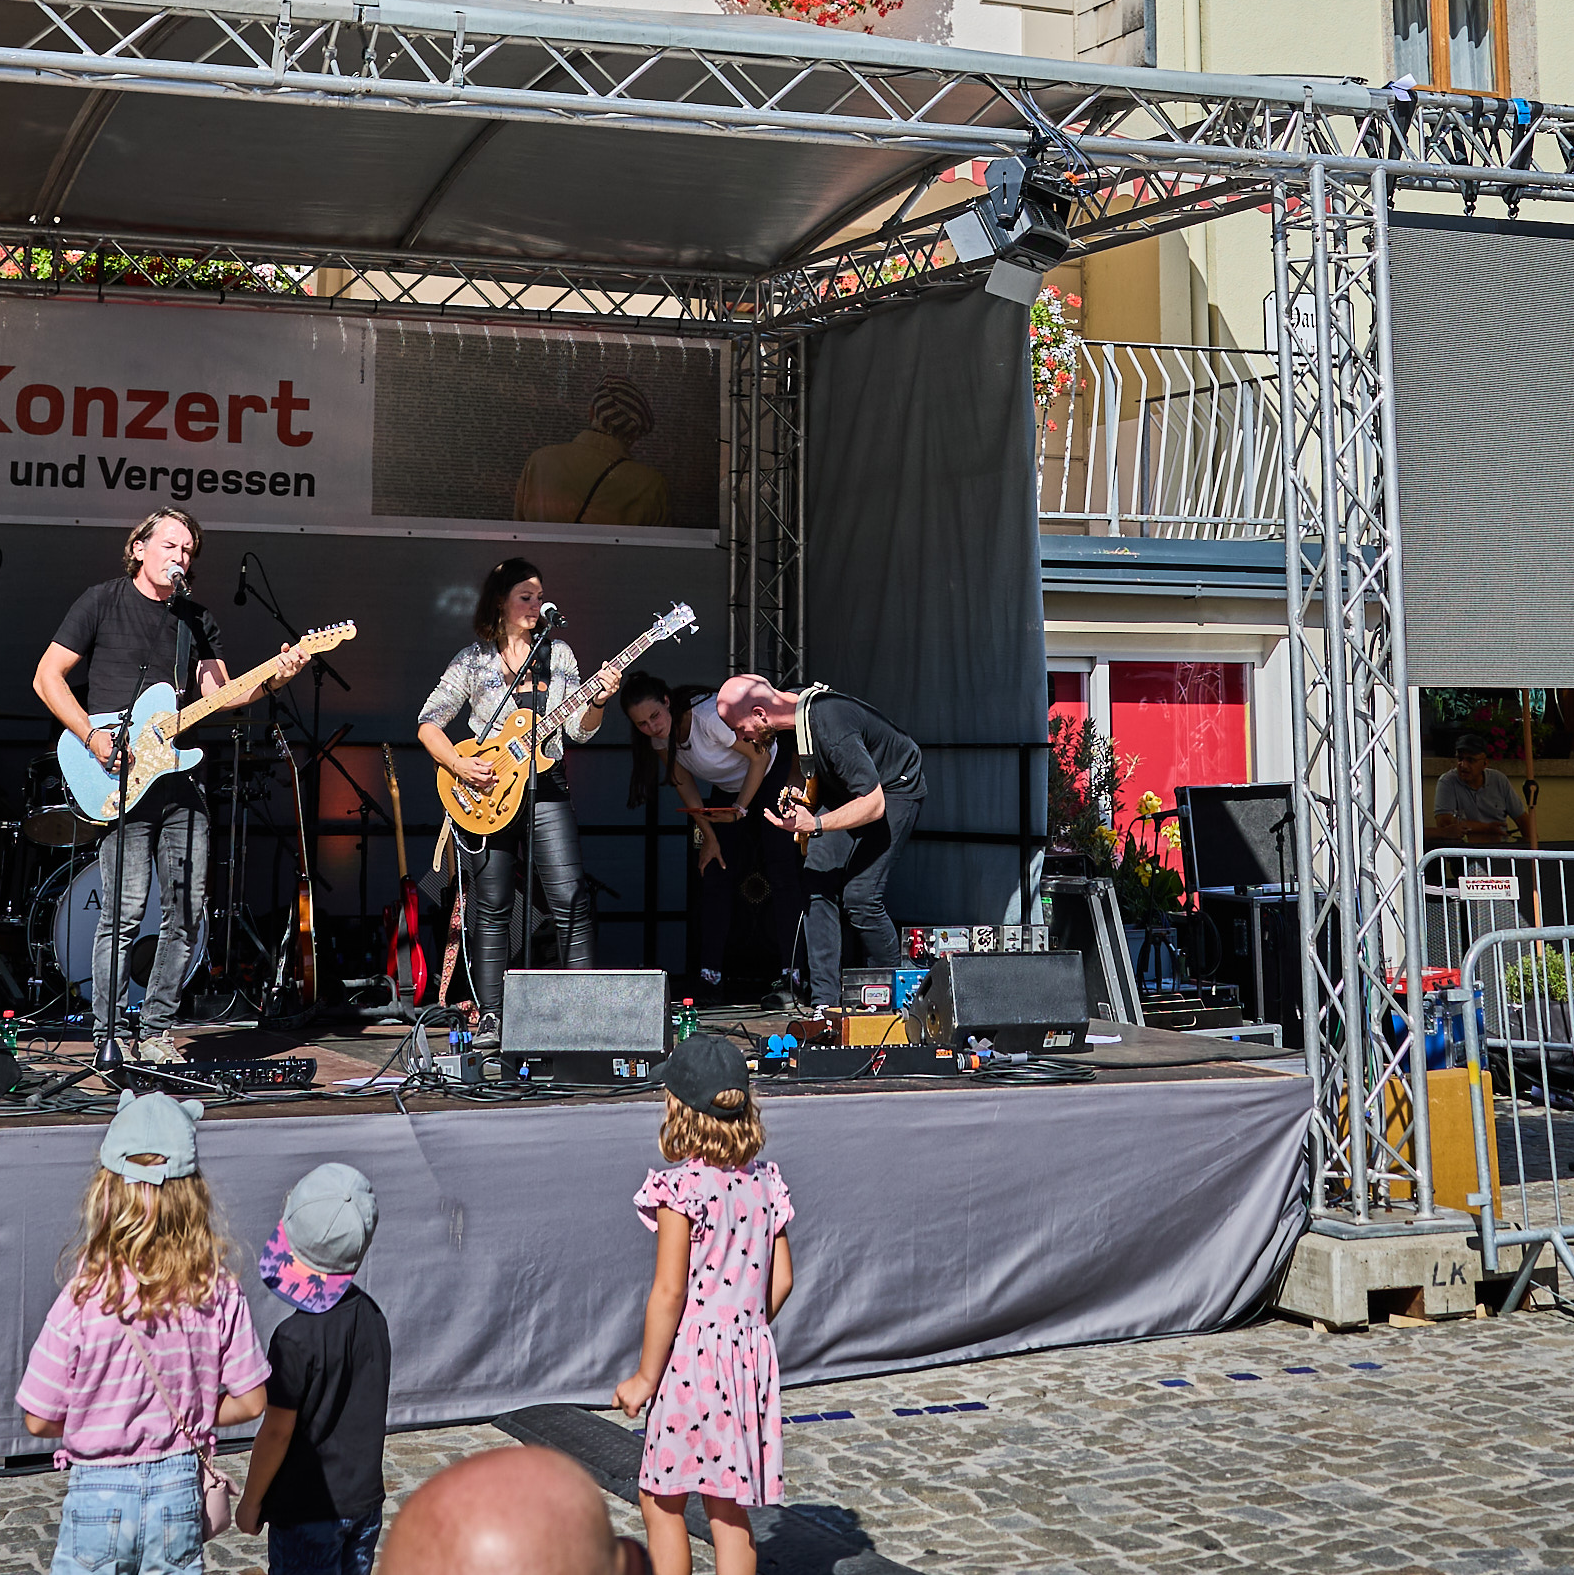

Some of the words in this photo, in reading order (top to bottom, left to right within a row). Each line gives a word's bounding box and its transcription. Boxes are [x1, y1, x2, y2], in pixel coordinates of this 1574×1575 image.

[8, 453, 87, 490] und
[97, 455, 317, 502] Vergessen
[1432, 1260, 1467, 1287] LK
